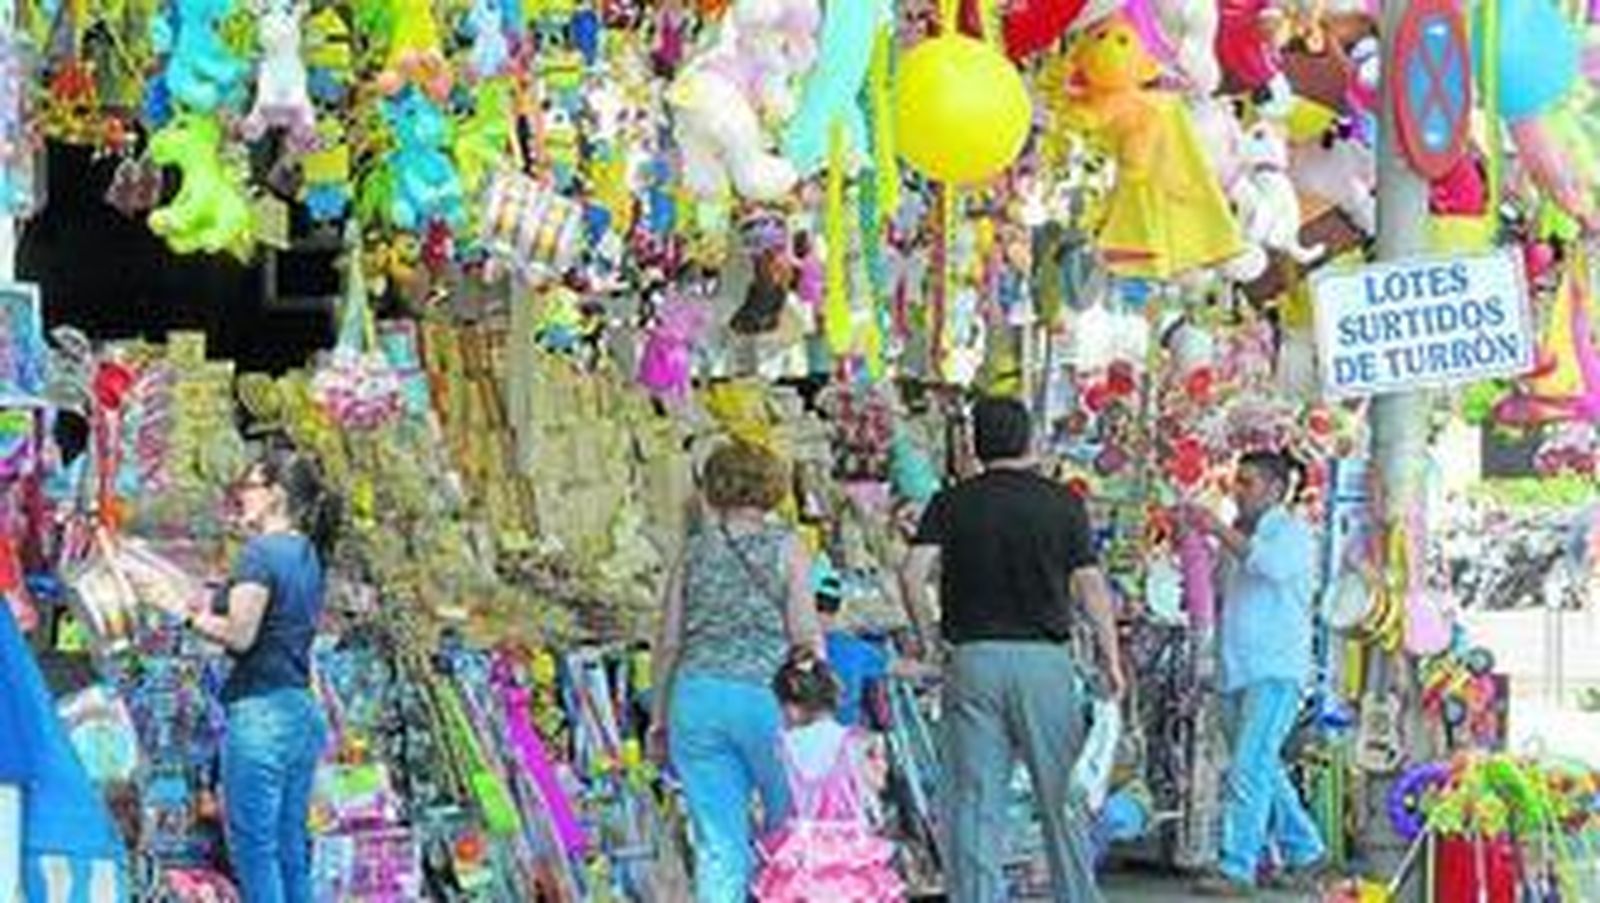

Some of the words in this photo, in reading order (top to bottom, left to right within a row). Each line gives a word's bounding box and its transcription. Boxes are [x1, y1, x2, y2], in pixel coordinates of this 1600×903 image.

[1365, 262, 1468, 304] LOTES
[1337, 296, 1505, 346] SURTIDOS
[1333, 352, 1376, 384] DE
